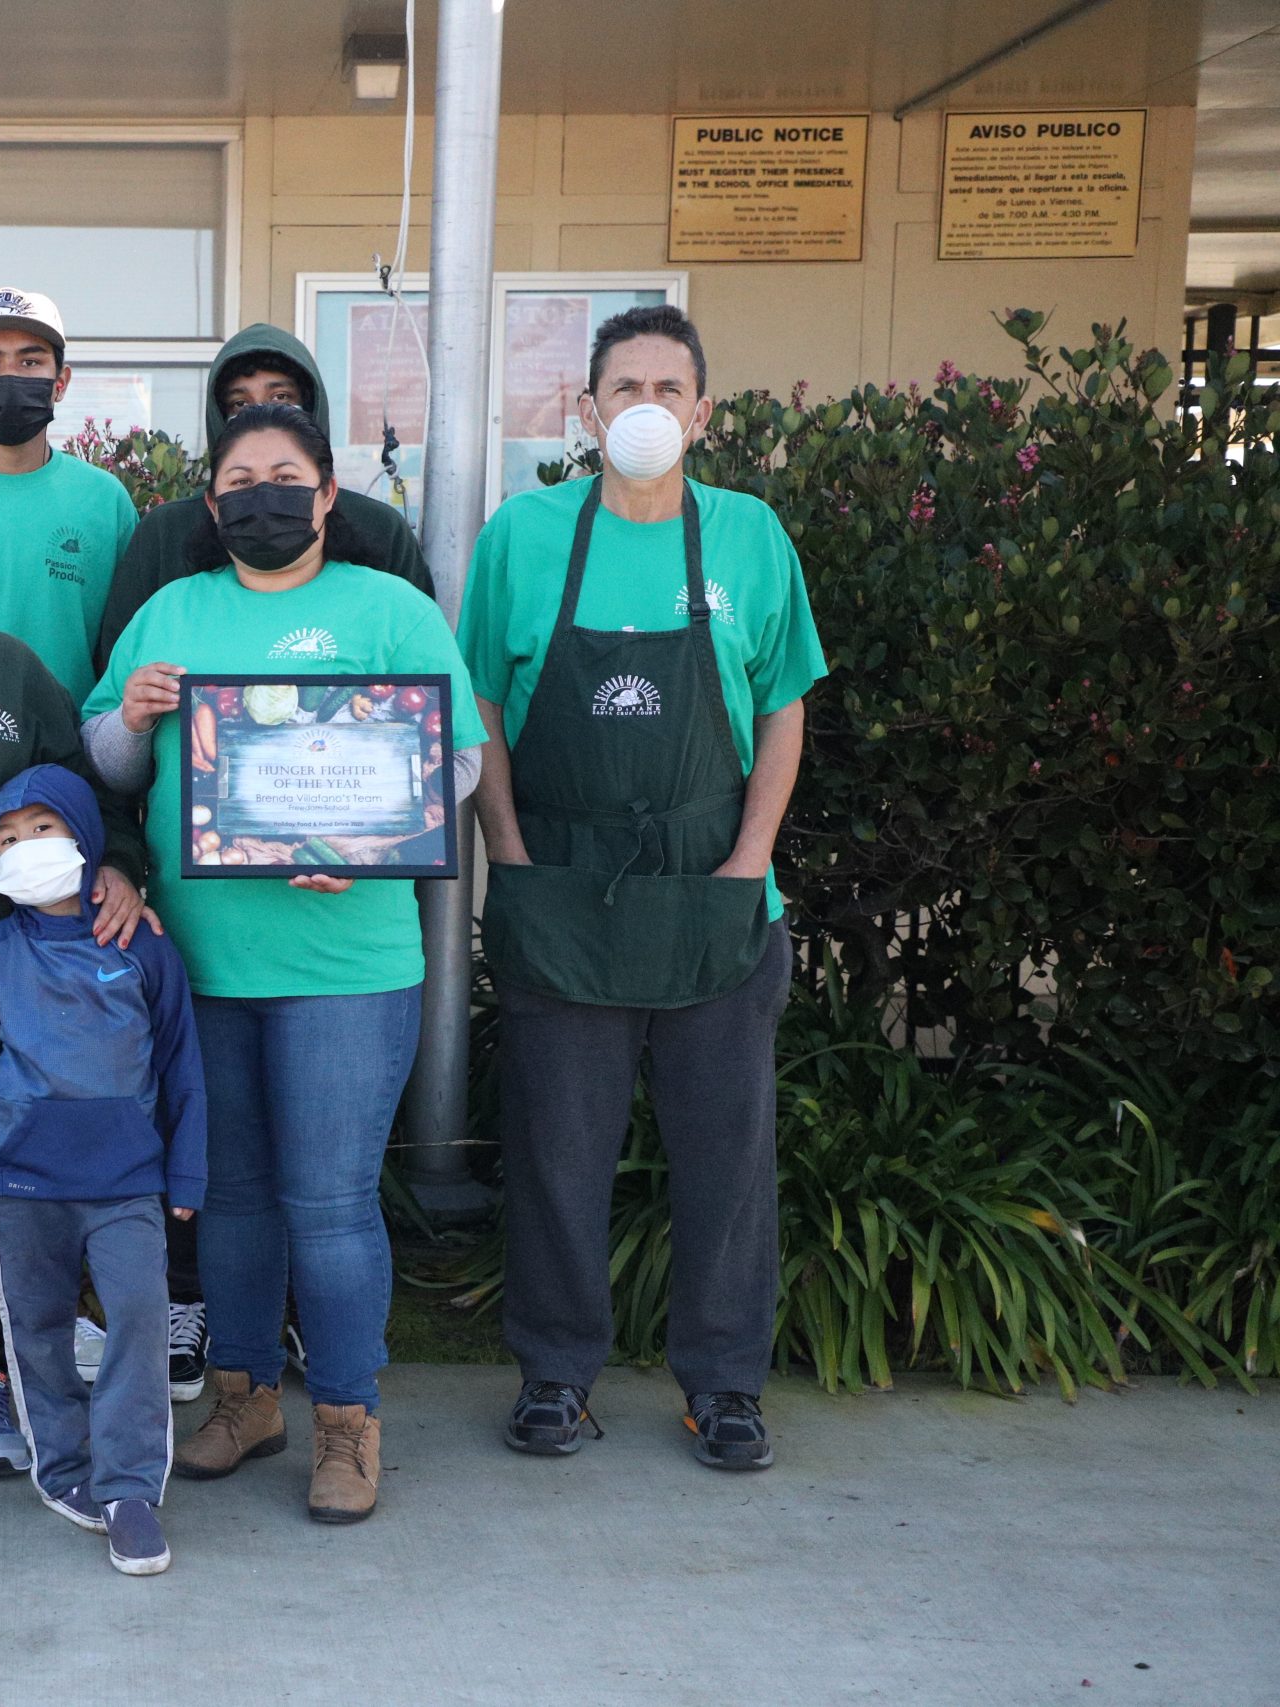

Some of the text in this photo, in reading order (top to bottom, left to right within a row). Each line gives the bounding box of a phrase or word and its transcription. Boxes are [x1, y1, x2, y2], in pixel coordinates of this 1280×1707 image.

[697, 128, 844, 142] PUBLIC NOTICE
[969, 123, 1121, 138] AVISO PUBLICO
[678, 168, 844, 177] MUST REGISTER THEIR PRESENCE
[1024, 173, 1031, 182] al
[1034, 173, 1057, 181] llegar
[1061, 172, 1067, 181] a
[1070, 172, 1088, 181] esta
[677, 180, 687, 188] IN
[692, 180, 709, 188] THE
[714, 180, 751, 188] SCHOOL
[756, 180, 789, 188] OFFICE
[1077, 185, 1083, 193] a
[1087, 185, 1095, 193] la
[1039, 198, 1046, 206] a
[978, 211, 989, 219] de
[992, 211, 1005, 219] las
[1008, 211, 1028, 219] 7:00
[1061, 210, 1082, 218] 4:30
[45, 558, 77, 571] Passion
[258, 766, 376, 775] HUNGER FIGHTER
[274, 780, 362, 788] OF THE YEAR
[256, 794, 294, 802] Brenda
[353, 794, 382, 802] Team
[9, 1183, 36, 1191] DRI-FIT
